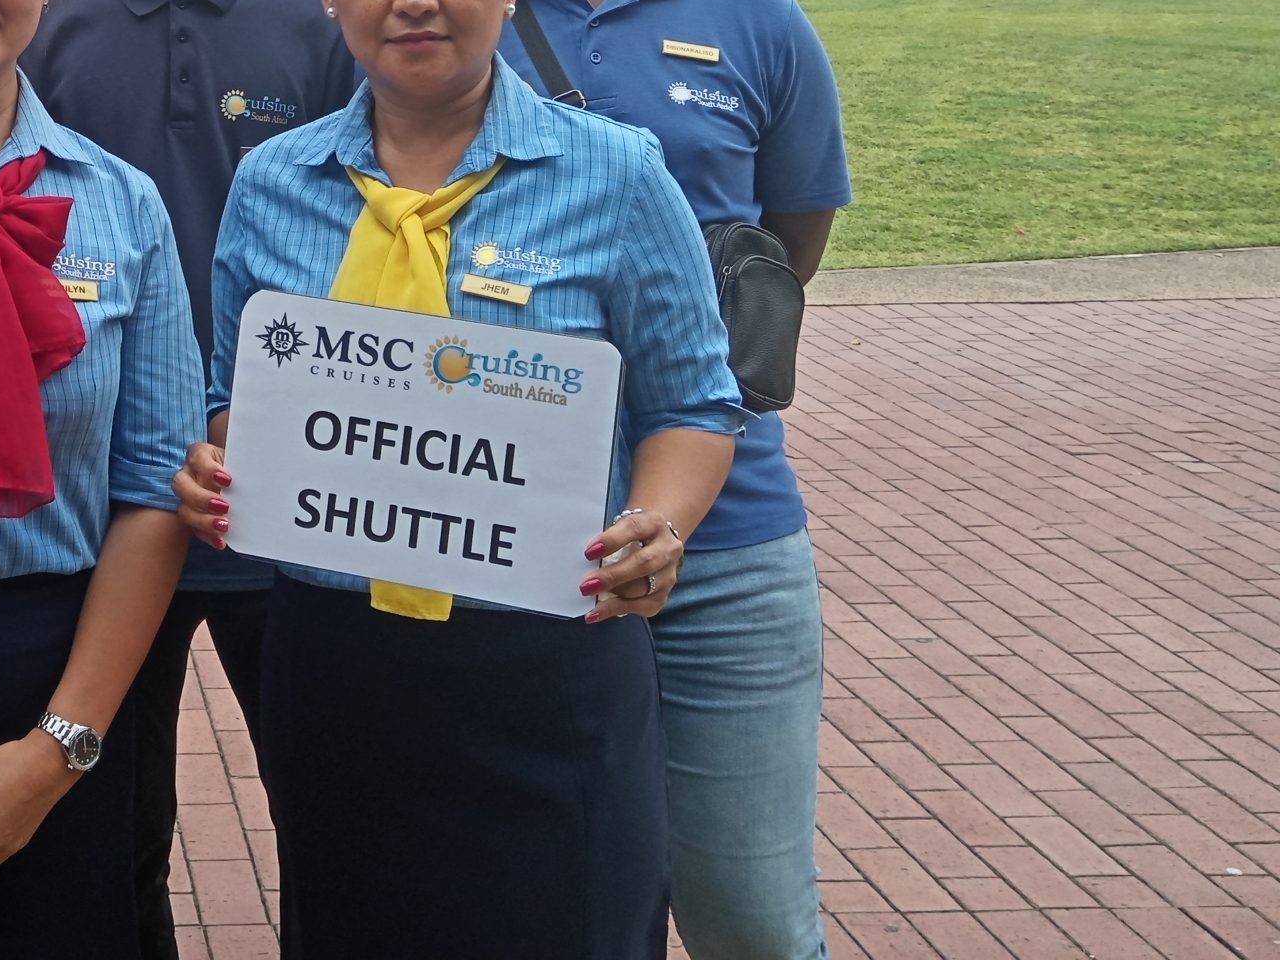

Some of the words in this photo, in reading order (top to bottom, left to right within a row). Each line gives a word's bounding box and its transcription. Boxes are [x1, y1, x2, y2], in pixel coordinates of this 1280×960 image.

[225, 95, 297, 118] Cruising
[251, 112, 271, 123] South
[52, 253, 116, 276] uising
[475, 245, 562, 271] Cruising
[504, 260, 527, 271] South
[60, 267, 82, 278] South
[481, 283, 510, 296] JHEM
[312, 325, 414, 372] MSC
[310, 365, 411, 391] CRUISES
[432, 345, 584, 394] Cruising
[483, 378, 523, 399] South
[525, 385, 568, 406] Africa
[304, 410, 526, 487] OFFICIAL
[294, 488, 517, 568] SHUTTLE
